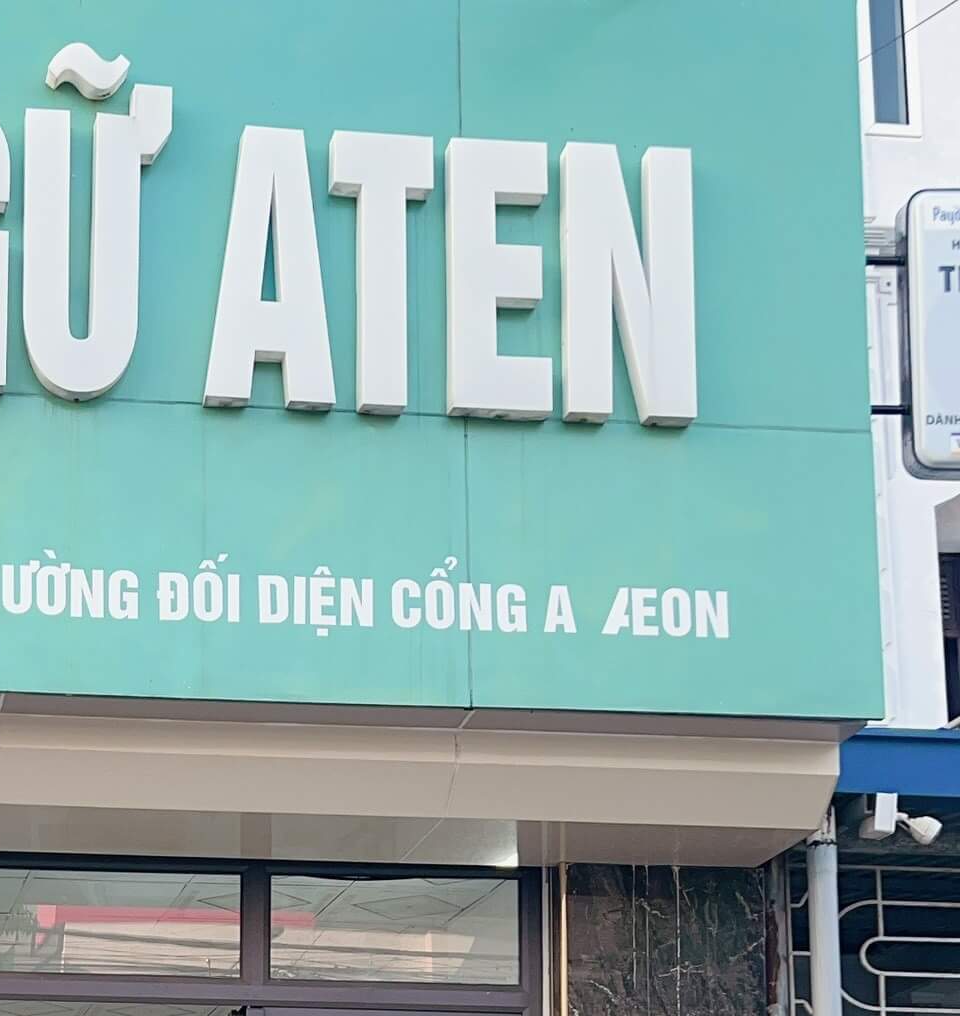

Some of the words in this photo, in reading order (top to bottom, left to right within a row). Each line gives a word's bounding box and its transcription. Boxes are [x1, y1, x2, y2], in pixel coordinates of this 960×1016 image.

[202, 125, 697, 428] ATEN
[156, 553, 240, 622] ĐỐI
[257, 566, 374, 637] DIỆN
[391, 556, 527, 632] CỔNG
[544, 585, 577, 634] A
